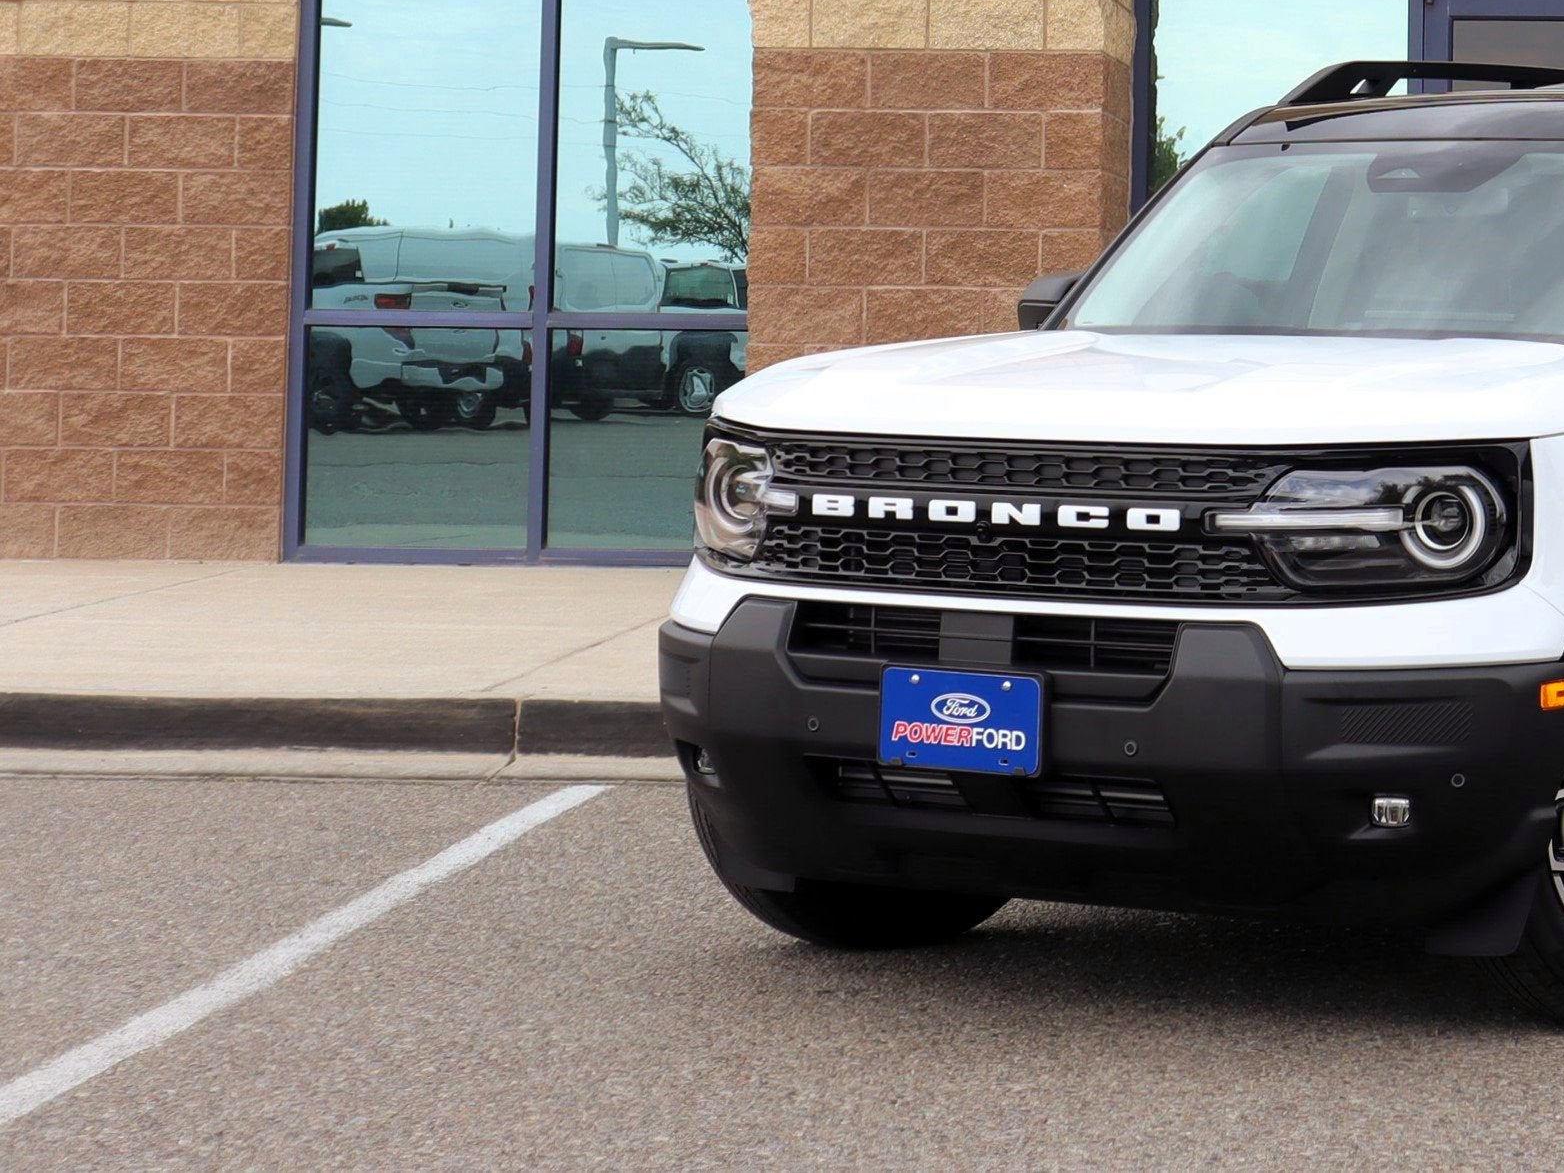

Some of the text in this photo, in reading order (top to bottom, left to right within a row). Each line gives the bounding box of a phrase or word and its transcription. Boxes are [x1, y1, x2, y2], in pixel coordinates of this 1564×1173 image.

[811, 493, 1181, 532] BRONCO
[942, 698, 978, 718] Ford
[891, 721, 1026, 751] POWERFORD
